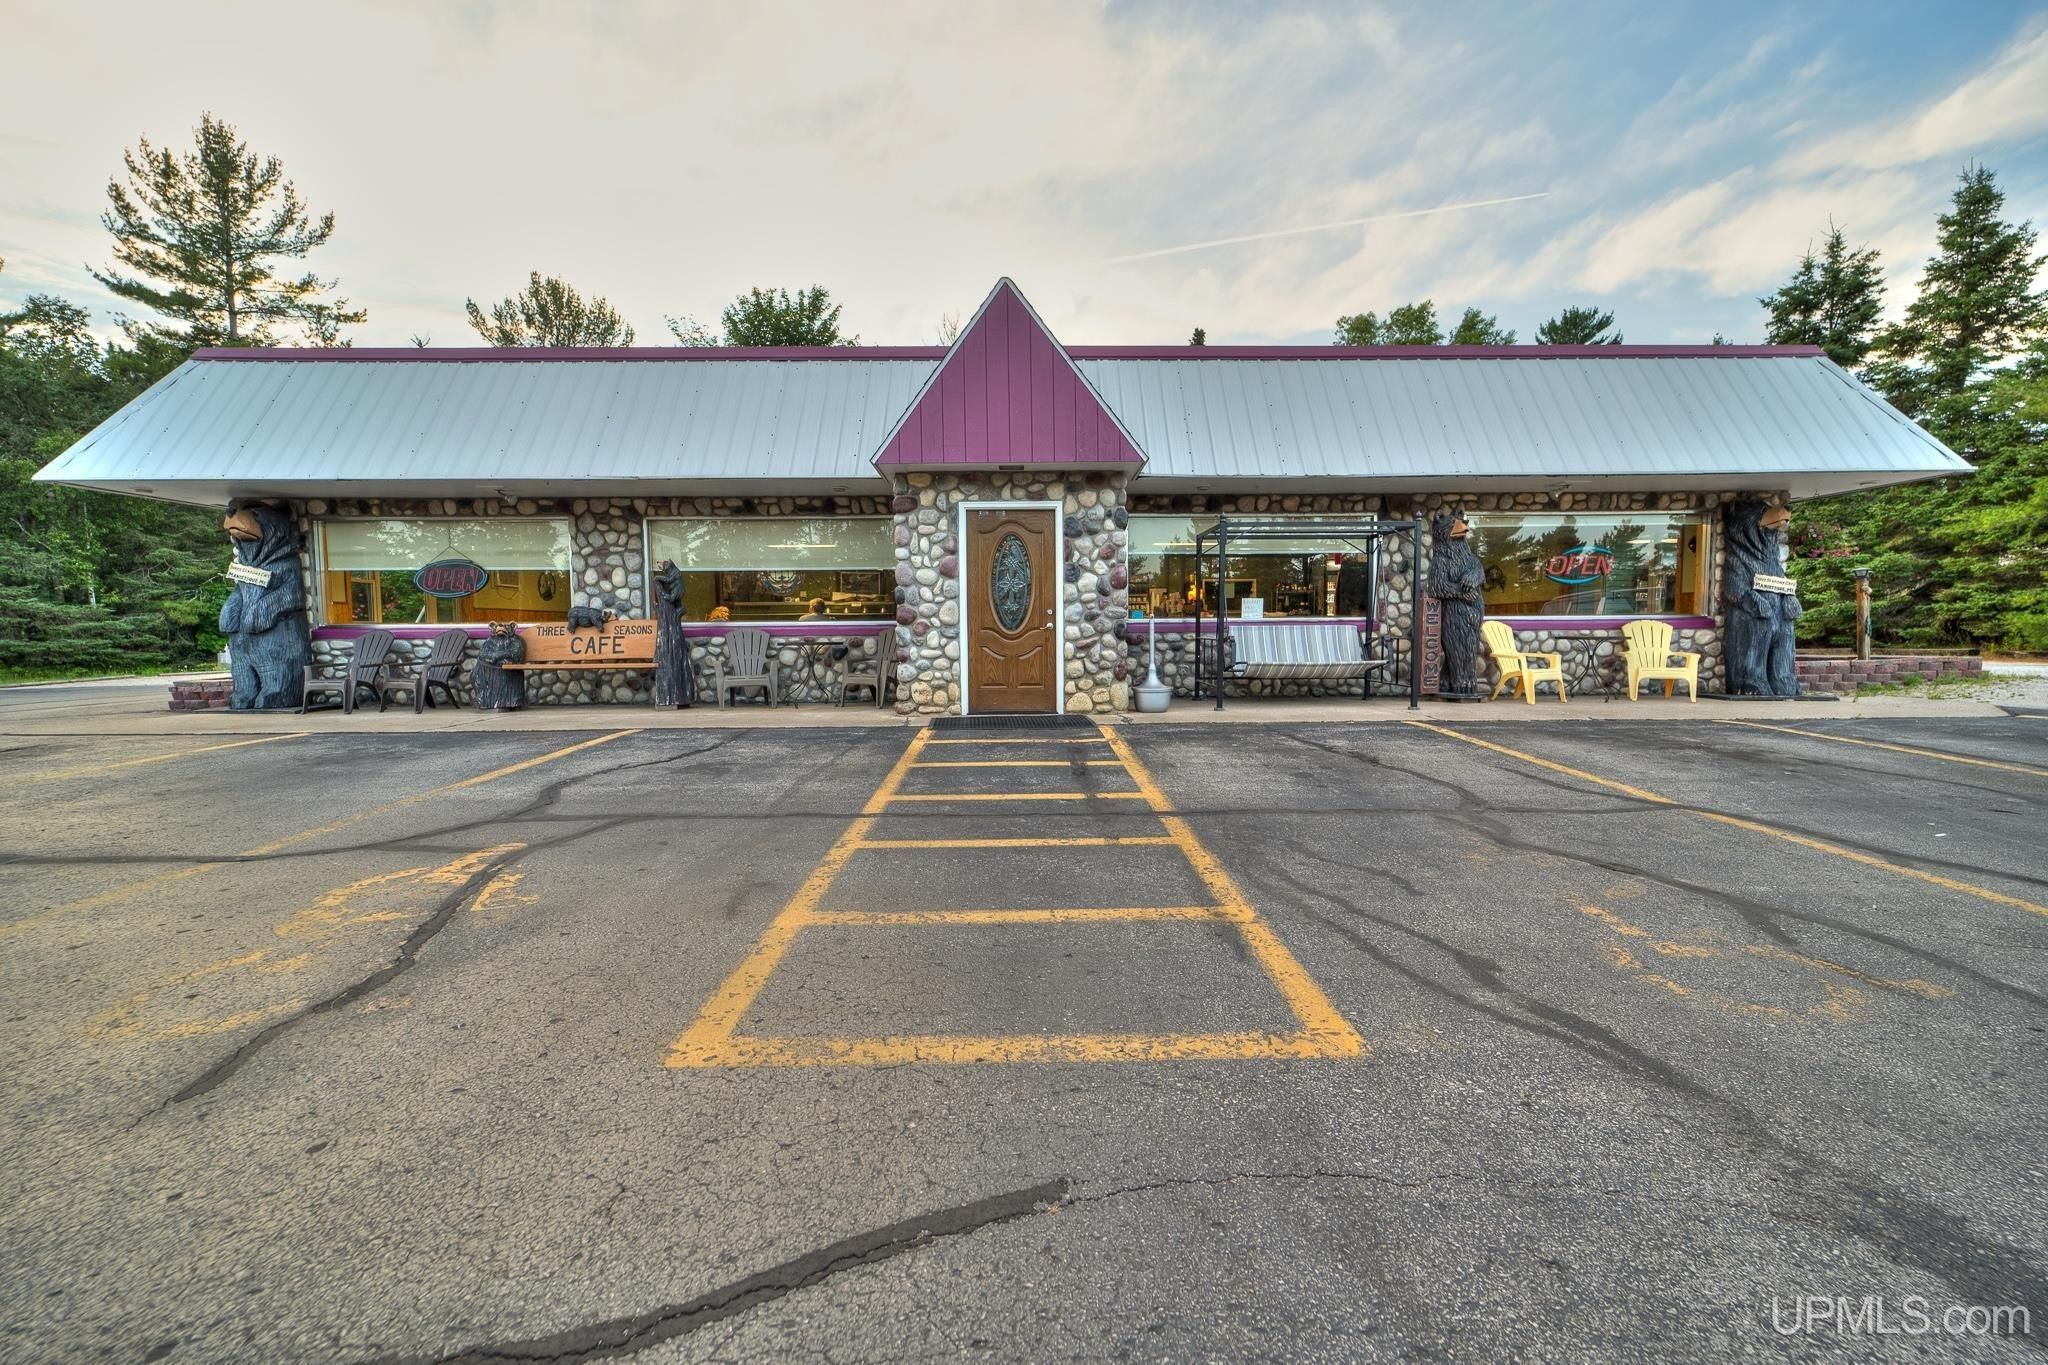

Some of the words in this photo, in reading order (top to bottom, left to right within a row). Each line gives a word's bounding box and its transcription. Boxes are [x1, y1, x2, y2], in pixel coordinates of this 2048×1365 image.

[1548, 554, 1615, 576] OPEN
[423, 567, 479, 592] OPEN
[537, 626, 565, 636] THREE
[614, 625, 653, 635] SEASONS
[570, 636, 625, 654] CAFE
[1424, 601, 1439, 688] WELCOME
